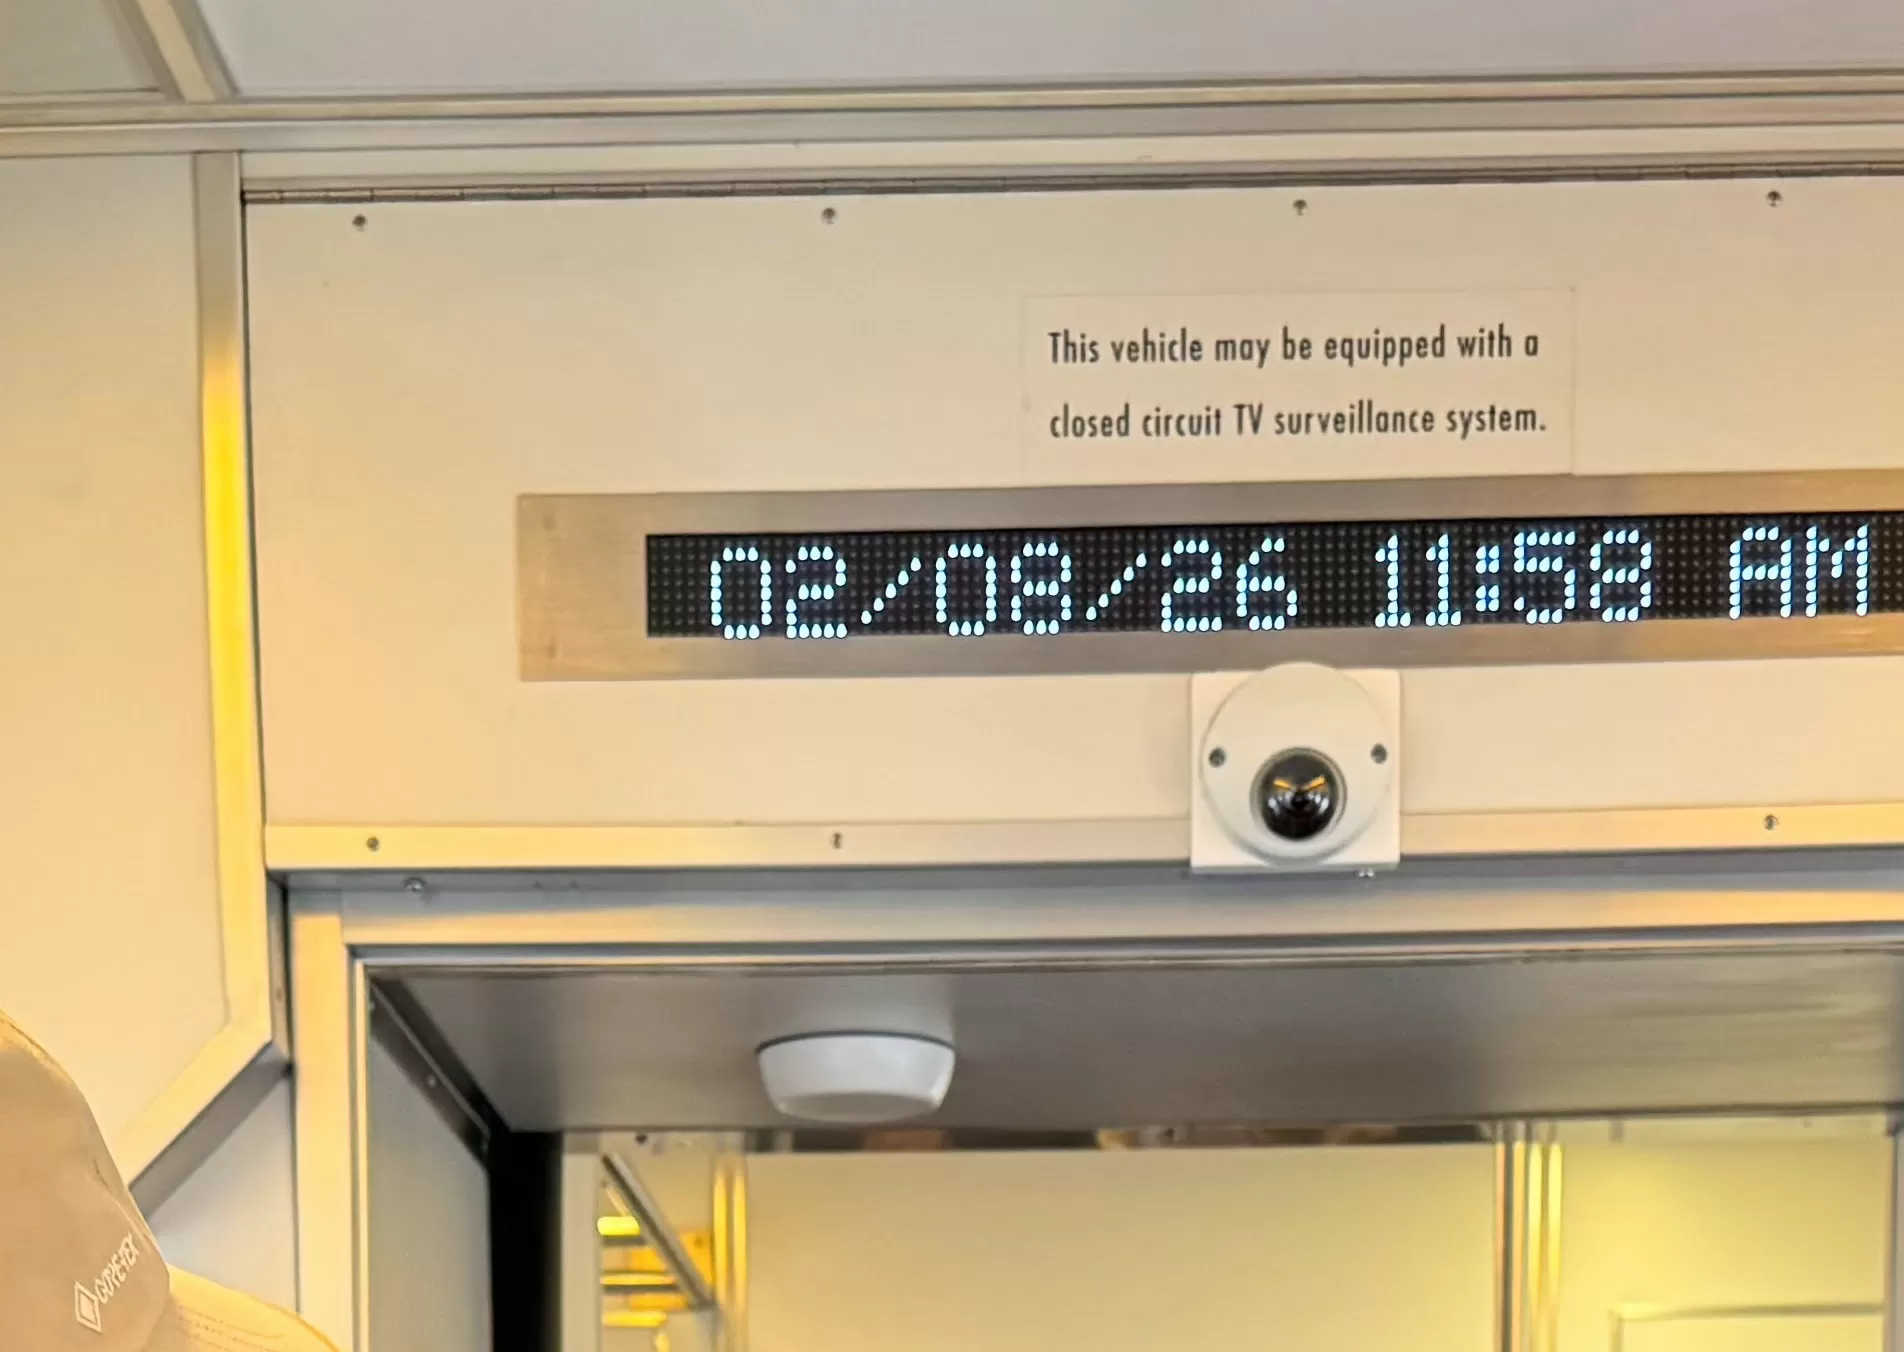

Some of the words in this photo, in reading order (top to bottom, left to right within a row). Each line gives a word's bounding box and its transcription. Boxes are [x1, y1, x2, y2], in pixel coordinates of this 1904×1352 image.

[1048, 331, 1099, 364] This
[1111, 328, 1202, 363] vehicle
[1216, 337, 1270, 368] may
[1282, 327, 1312, 360] be
[1324, 323, 1445, 367] equipped
[1457, 323, 1512, 357] with
[1525, 334, 1538, 357] a
[1049, 402, 1130, 438] closed
[1142, 404, 1221, 436] circuit
[1234, 403, 1263, 434] TV
[1274, 400, 1435, 434] surveillance
[1446, 402, 1547, 440] system.
[711, 537, 1298, 639] 02/08/26
[1375, 528, 1652, 627] 11:58
[1729, 524, 1870, 619] AM
